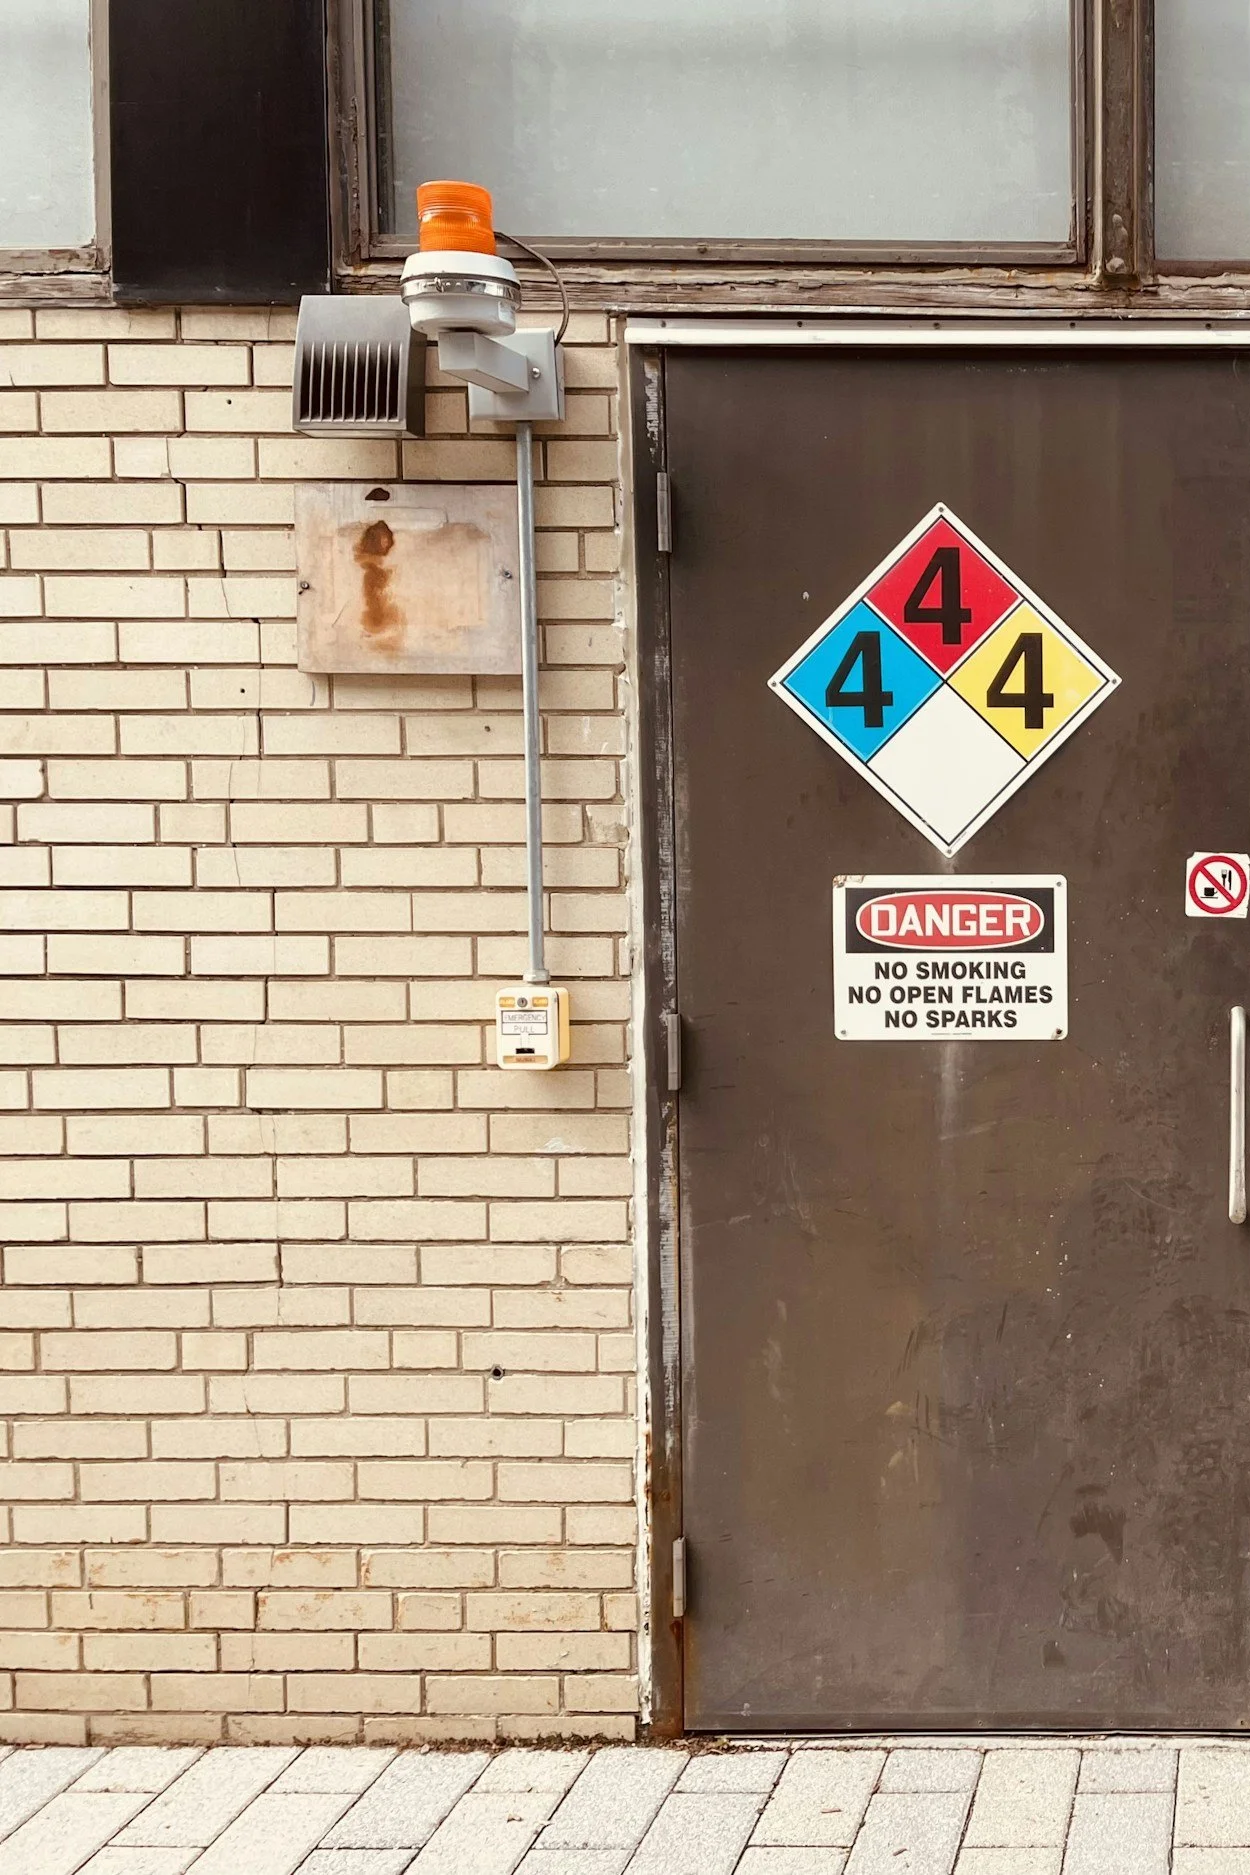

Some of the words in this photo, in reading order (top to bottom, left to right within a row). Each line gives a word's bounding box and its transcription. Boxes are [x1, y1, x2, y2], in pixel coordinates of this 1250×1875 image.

[904, 547, 971, 645] 4
[825, 631, 893, 728] 4
[986, 632, 1054, 729] 4
[870, 903, 1031, 937] DANGER
[874, 961, 908, 980] NO
[915, 961, 1026, 980] SMOKING
[848, 985, 882, 1004] NO
[889, 985, 954, 1004] OPEN
[961, 985, 1053, 1004] FLAMES
[513, 1025, 536, 1034] PULL
[884, 1010, 918, 1029] NO
[925, 1009, 1018, 1028] SPARKS
